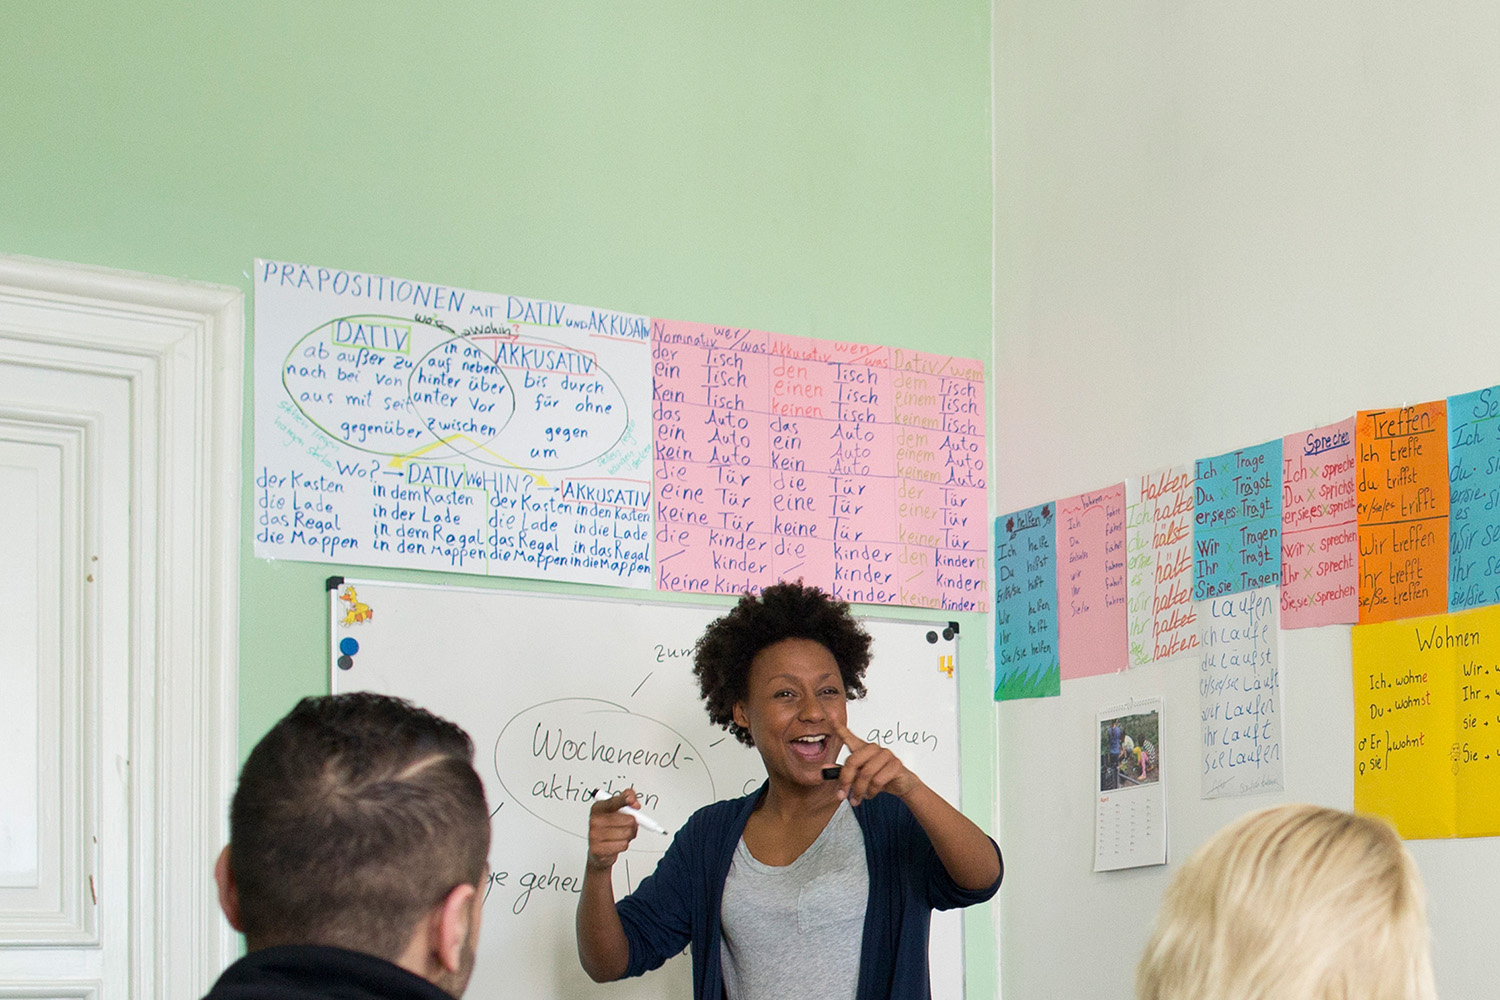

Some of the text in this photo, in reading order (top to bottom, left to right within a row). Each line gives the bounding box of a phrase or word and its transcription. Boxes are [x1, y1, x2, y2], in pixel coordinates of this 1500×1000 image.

[263, 261, 465, 313] PRÄPOSITIONEN
[470, 306, 500, 317] MIT
[507, 296, 565, 326] DATIV
[336, 320, 408, 350] DATIV
[304, 342, 329, 359] ab
[444, 344, 480, 359] in an
[496, 343, 593, 374] AKKUSATIV
[702, 347, 743, 370] Tisch
[287, 364, 326, 379] nach
[338, 367, 361, 382] bei
[428, 358, 498, 374] auf neben
[655, 363, 747, 387] ein Tisch
[834, 362, 878, 384] Tisch
[418, 367, 505, 394] hinter über
[524, 371, 603, 394] bis durch
[300, 392, 333, 404] aus
[346, 390, 372, 407] mit
[414, 388, 457, 407] unter
[536, 394, 612, 415] für ohne
[701, 385, 745, 409] Tisch
[654, 402, 748, 428] das Auto
[341, 420, 422, 442] gegenüber
[545, 426, 588, 440] gegen
[531, 448, 558, 458] um
[1361, 444, 1379, 462] Ich
[257, 467, 344, 493] der Kasten
[408, 463, 463, 488] DATIV
[656, 464, 750, 487] die Tür
[259, 490, 333, 513] die Lade
[563, 482, 650, 506] AKKUSATIV
[260, 511, 341, 534] das Regal
[257, 528, 358, 556] die Mappen
[1415, 626, 1480, 651] Wohnen
[1370, 670, 1428, 690] Ich wohne
[1463, 661, 1482, 677] Wir
[1370, 691, 1431, 719] Du wohnst
[1463, 686, 1481, 701] Ihr
[531, 721, 695, 770] Wochenend-
[1371, 732, 1425, 751] Er wohnt
